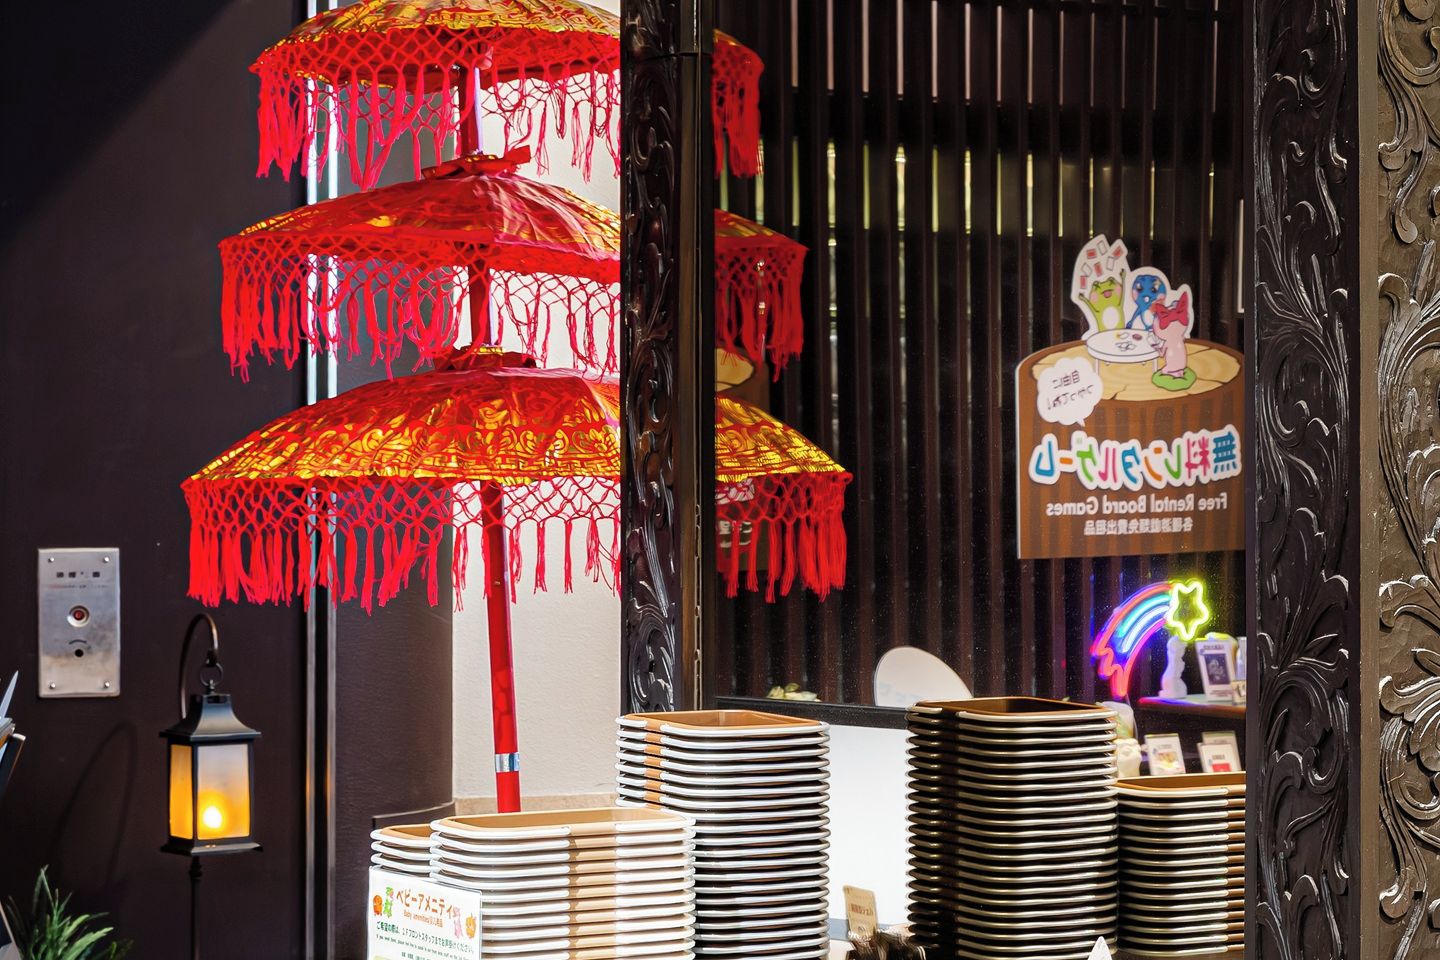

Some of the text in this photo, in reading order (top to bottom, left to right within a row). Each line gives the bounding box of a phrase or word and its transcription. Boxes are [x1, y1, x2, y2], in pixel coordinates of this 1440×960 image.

[396, 887, 456, 920] ベビーアメニティ
